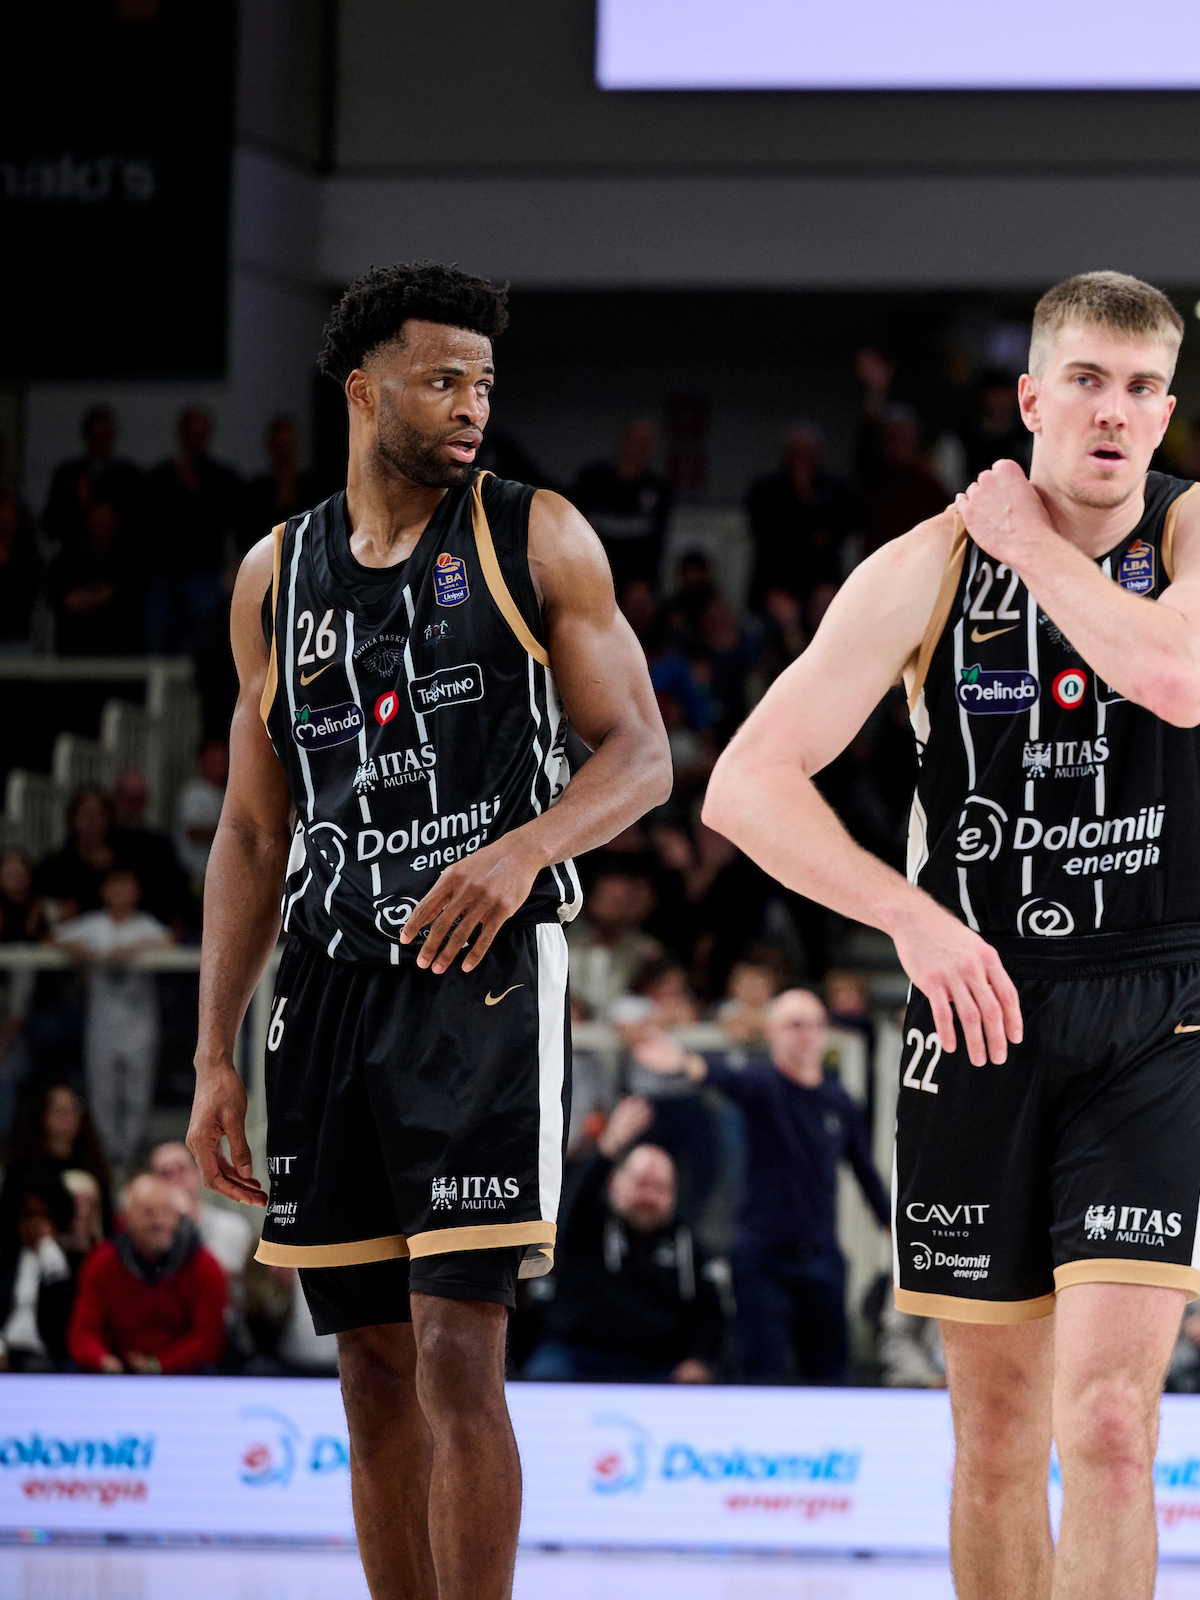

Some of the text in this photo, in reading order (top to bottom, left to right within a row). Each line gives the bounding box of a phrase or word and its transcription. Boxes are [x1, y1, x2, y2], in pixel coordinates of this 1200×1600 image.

[1123, 560, 1150, 572] LBA
[438, 573, 463, 586] LBA
[969, 561, 1020, 620] 22
[443, 590, 464, 601] Unipol
[297, 609, 337, 666] 26
[353, 636, 377, 660] AQUILA
[379, 634, 405, 644] BASKE
[960, 679, 1036, 701] Melinda
[296, 711, 361, 740] Melinda
[379, 745, 437, 777] ITAS
[1055, 736, 1110, 766] ITAS
[384, 770, 426, 788] MUTUA
[1054, 766, 1096, 779] MUTUA
[357, 795, 500, 862] Dolomiti
[1013, 805, 1166, 850] Dolomiti
[267, 997, 288, 1052] 6
[903, 1028, 942, 1094] 22
[462, 1176, 520, 1199] ITAS
[461, 1200, 506, 1210] MUTUA
[906, 1203, 990, 1226] CAVIT
[1117, 1206, 1182, 1237] ITAS
[1115, 1231, 1165, 1247] MUTUA
[935, 1252, 991, 1268] Dolomiti
[953, 1269, 988, 1281] energia
